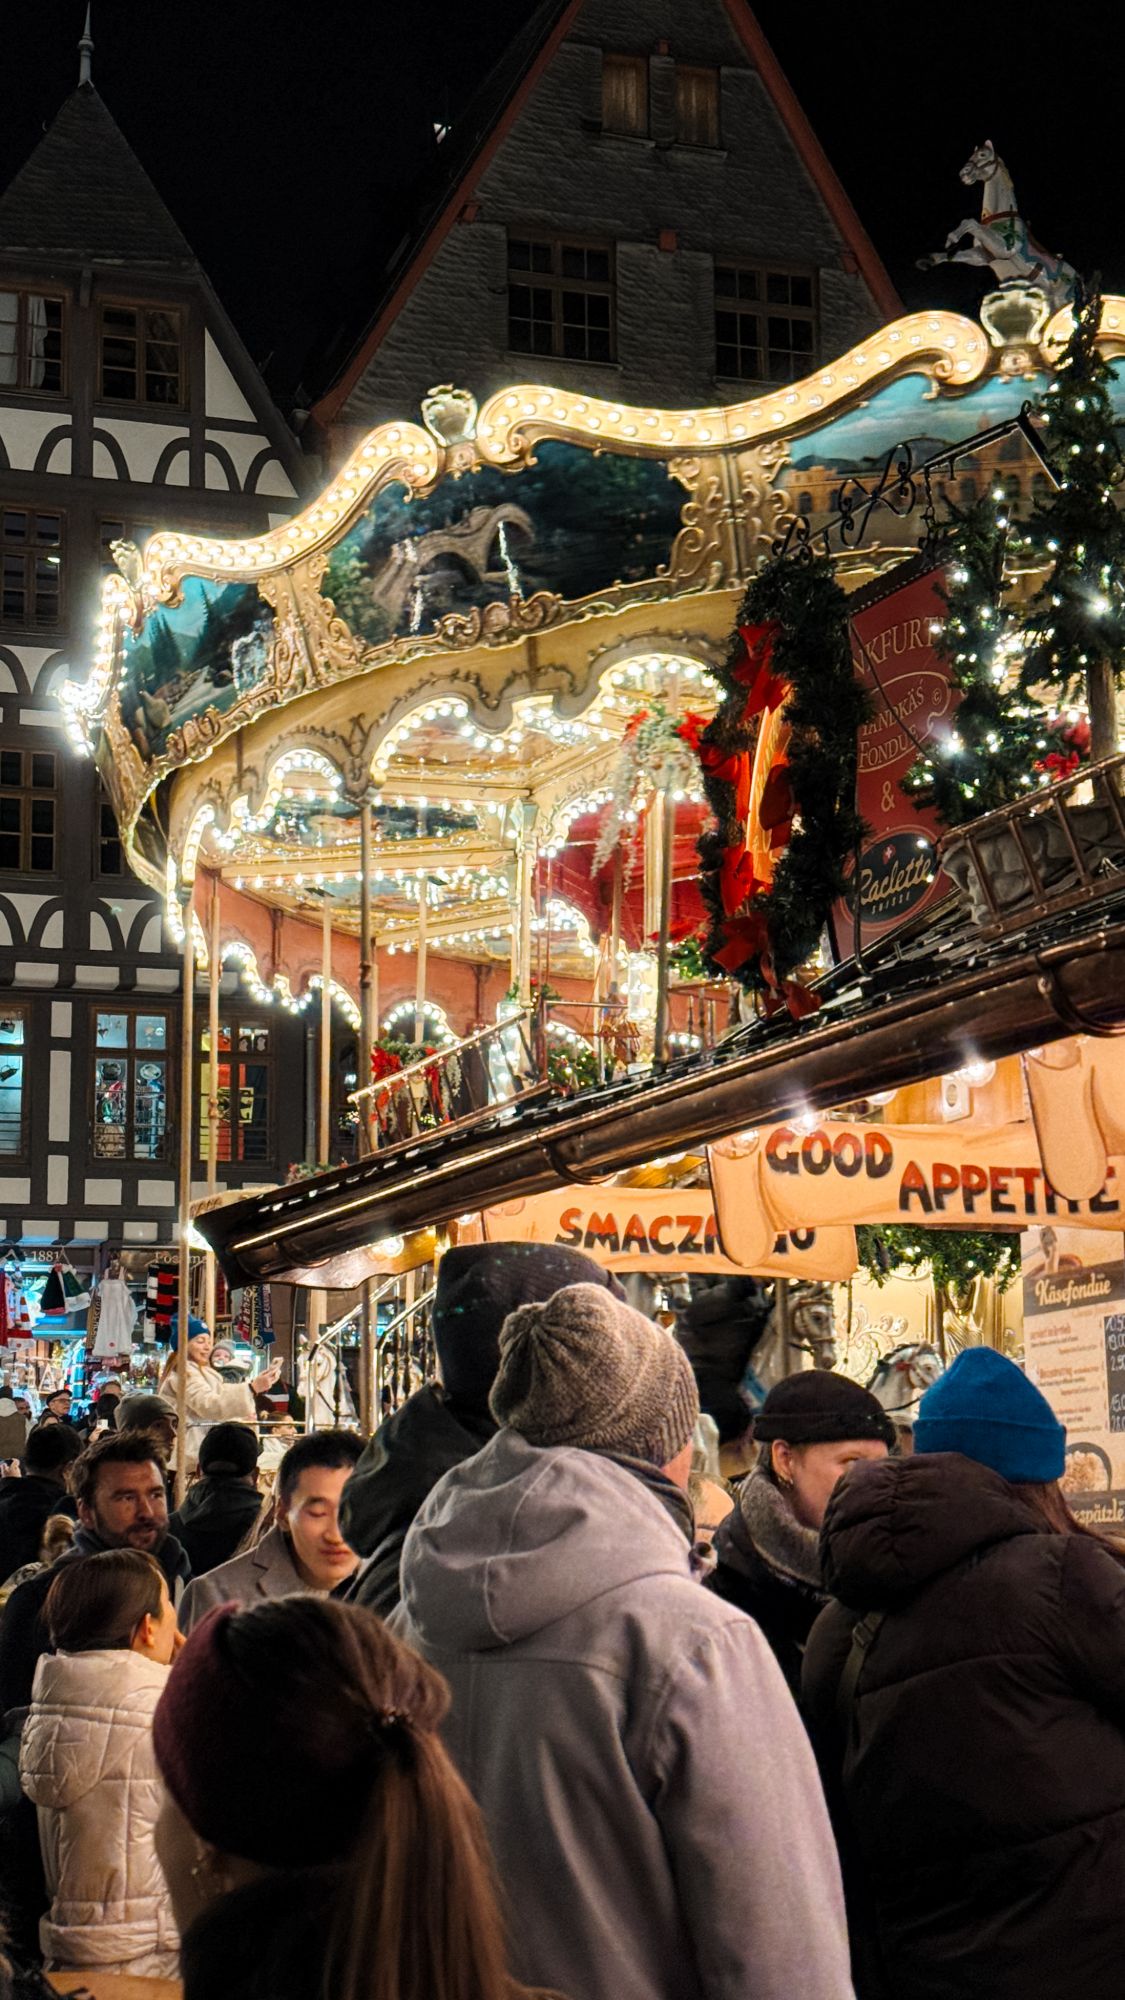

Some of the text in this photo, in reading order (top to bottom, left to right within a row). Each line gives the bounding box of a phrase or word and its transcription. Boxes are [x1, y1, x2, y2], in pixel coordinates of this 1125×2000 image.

[881, 780, 895, 812] &
[857, 853, 932, 906] Raclette
[764, 1127, 893, 1178] GOOD
[1073, 1498, 1125, 1528] espätzle
